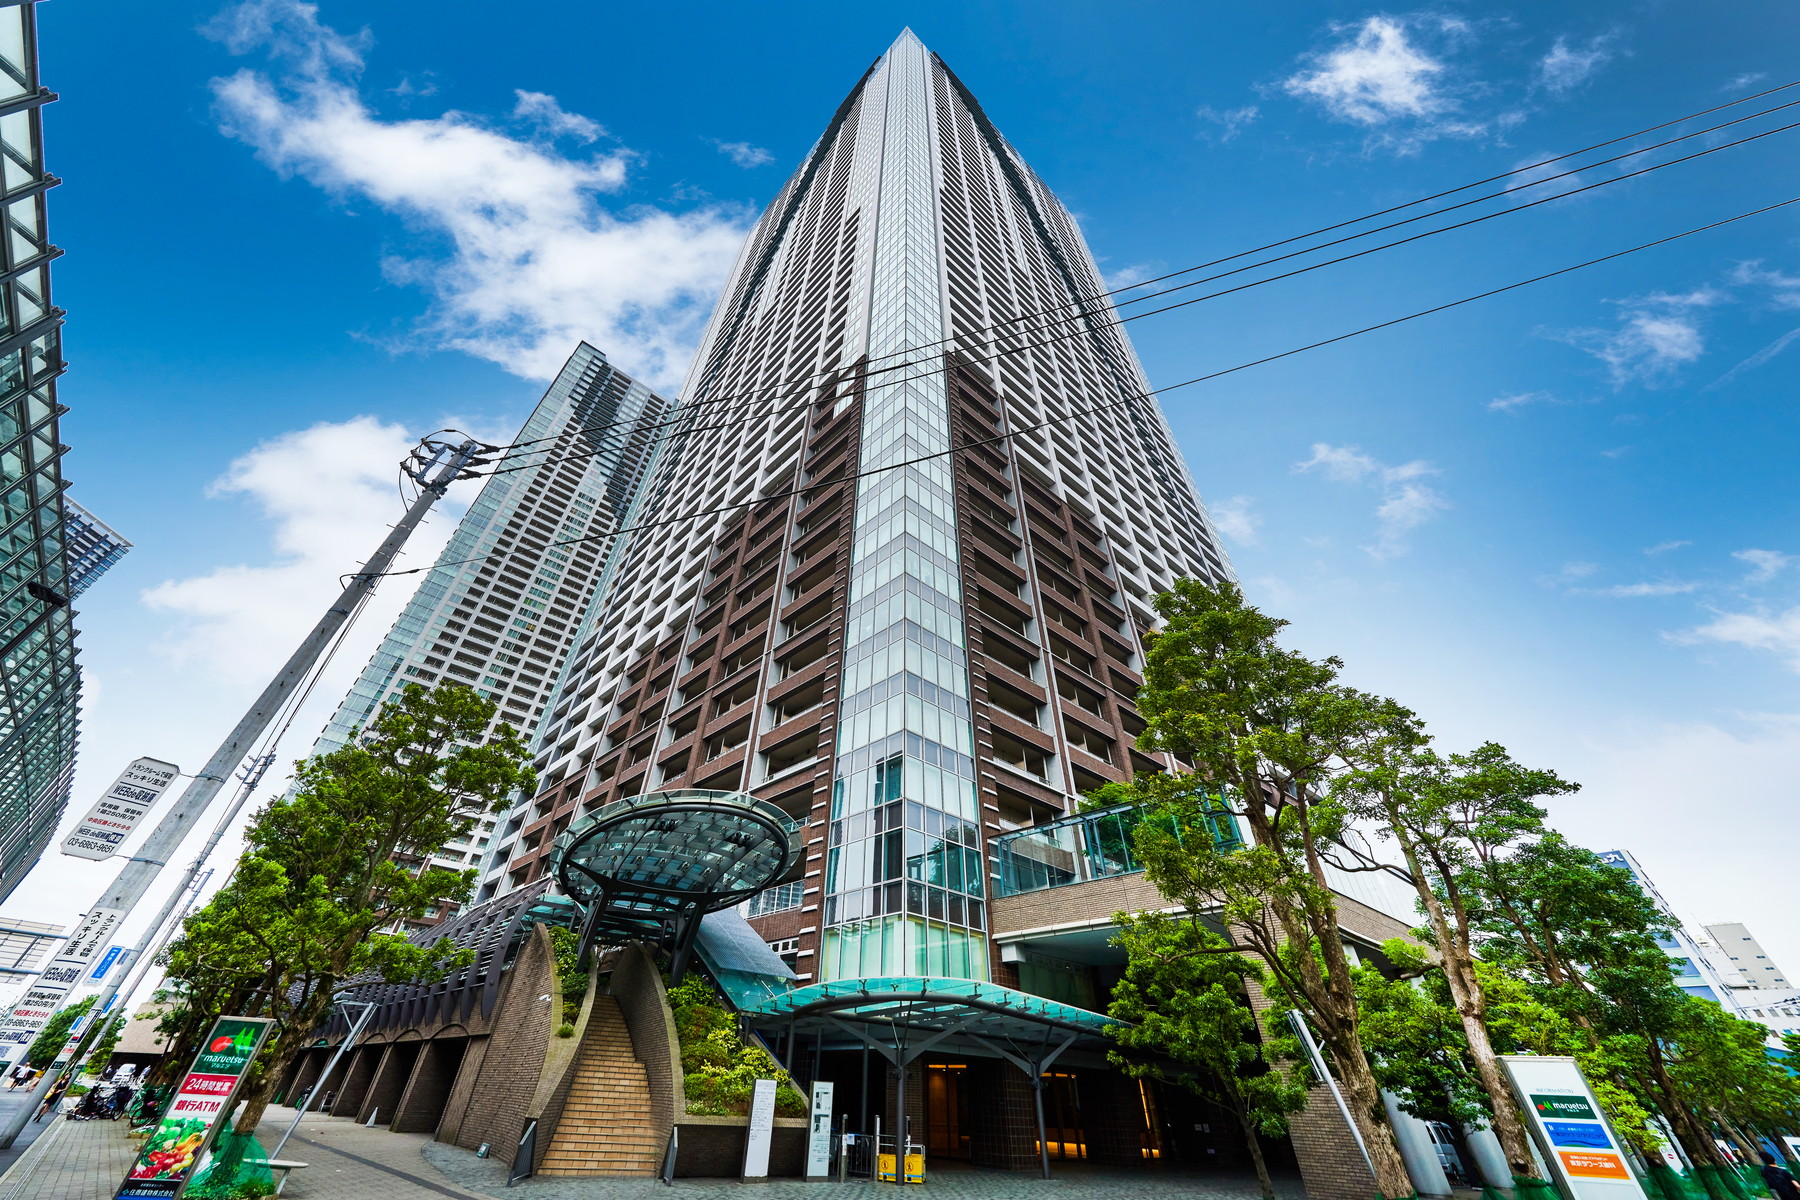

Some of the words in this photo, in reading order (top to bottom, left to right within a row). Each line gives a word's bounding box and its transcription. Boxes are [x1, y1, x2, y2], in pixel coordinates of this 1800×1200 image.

[125, 771, 169, 788] スッキリ生活
[67, 837, 115, 854] 03-6863-9651
[63, 911, 103, 956] スッキリ生活
[203, 1054, 244, 1064] maruetsu
[185, 1078, 232, 1092] 24時間営業
[174, 1099, 222, 1113] 銀行ATM
[1552, 1102, 1589, 1110] maruetsu
